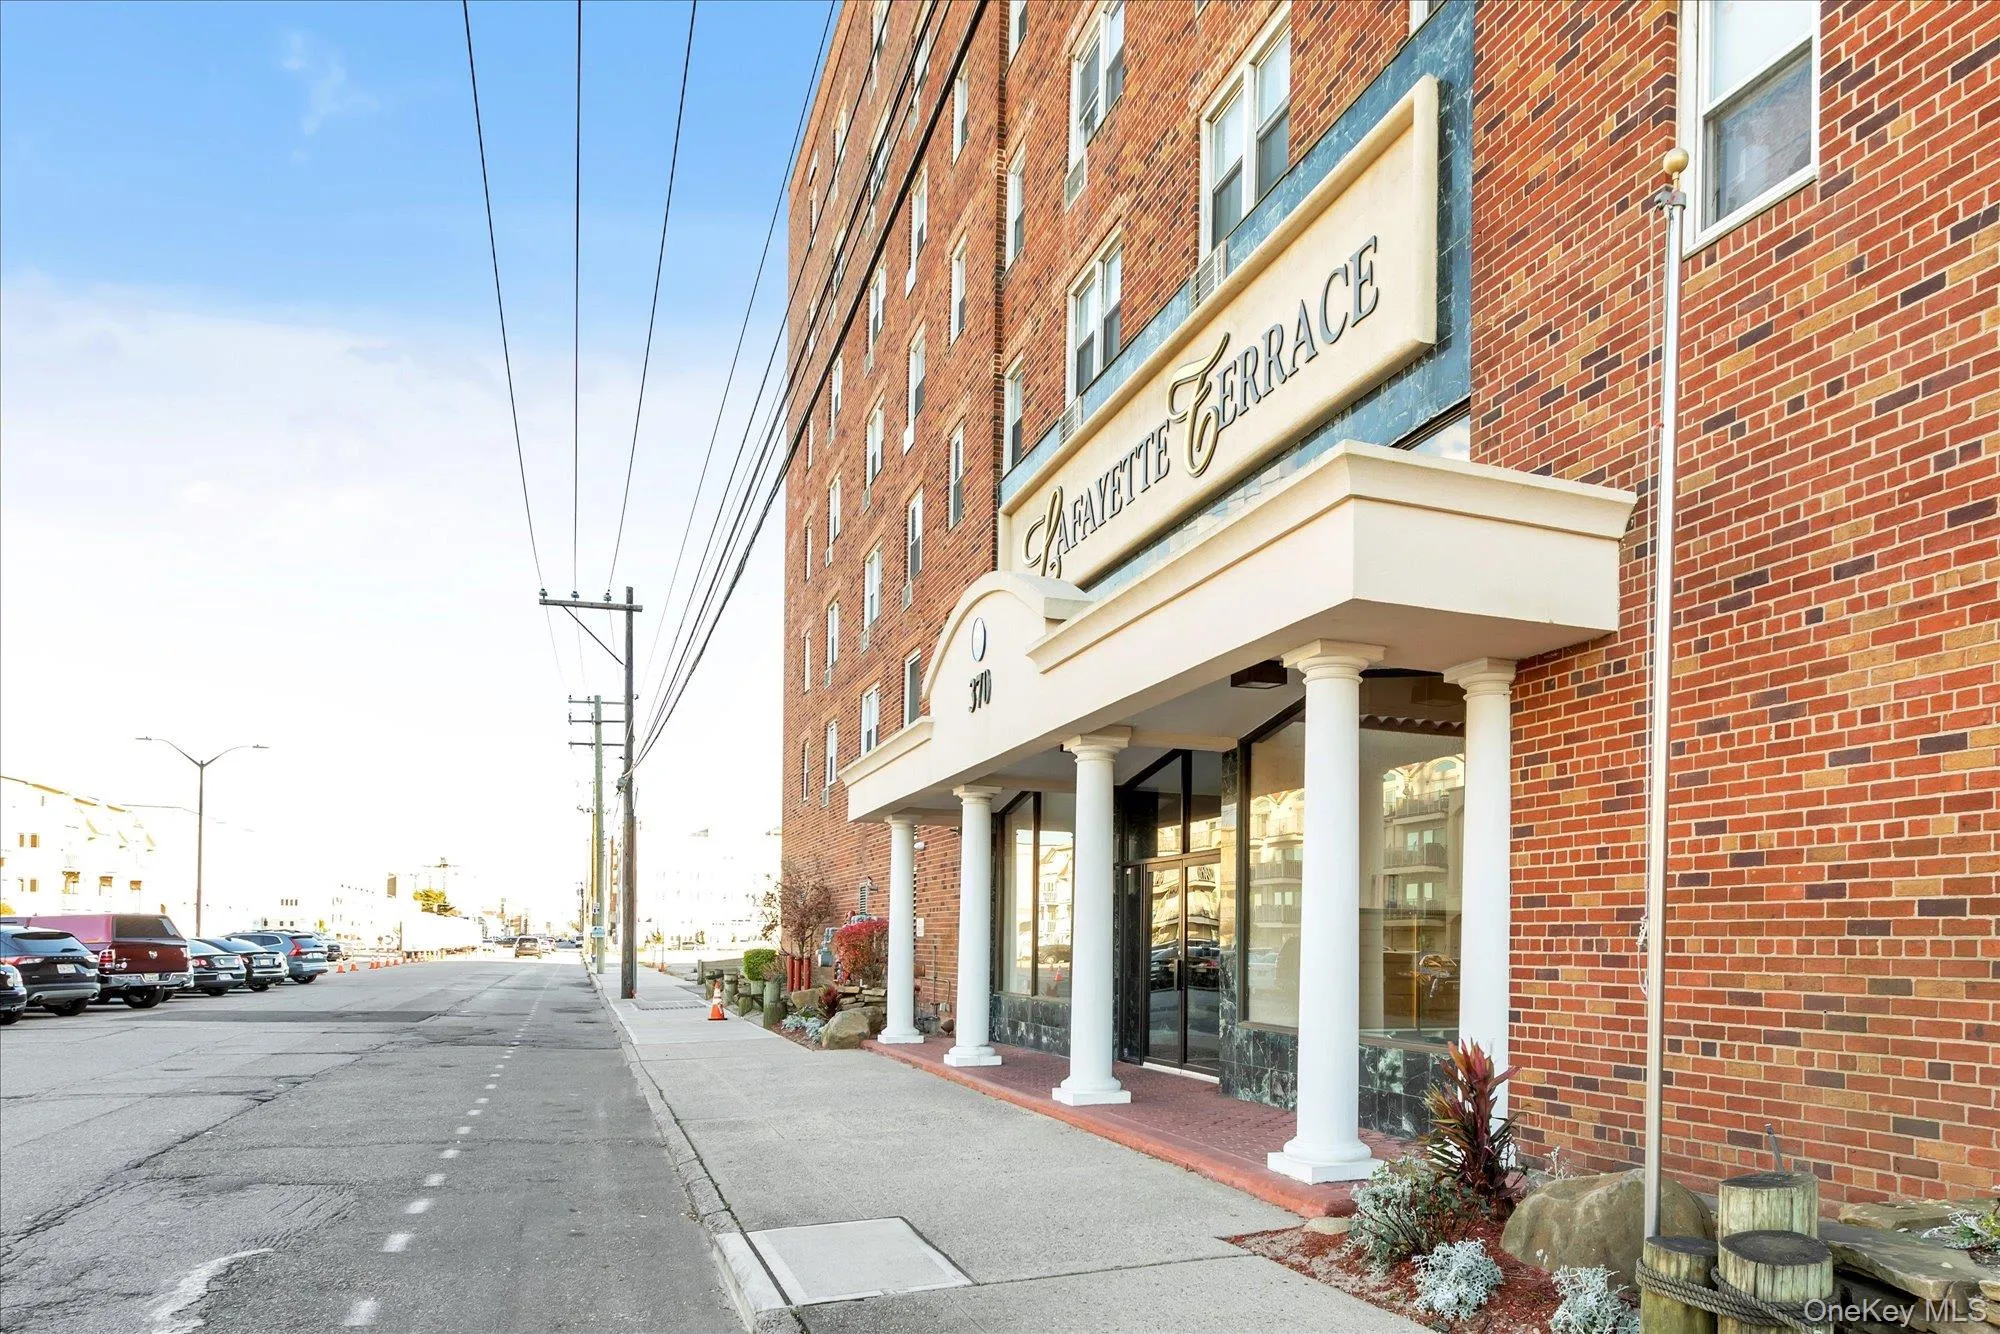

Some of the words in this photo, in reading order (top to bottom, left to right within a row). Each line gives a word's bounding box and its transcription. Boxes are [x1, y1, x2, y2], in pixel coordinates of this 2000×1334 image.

[1022, 419, 1173, 579] LAFAYETTE
[1166, 234, 1380, 479] TERRACE
[968, 669, 992, 713] 370
